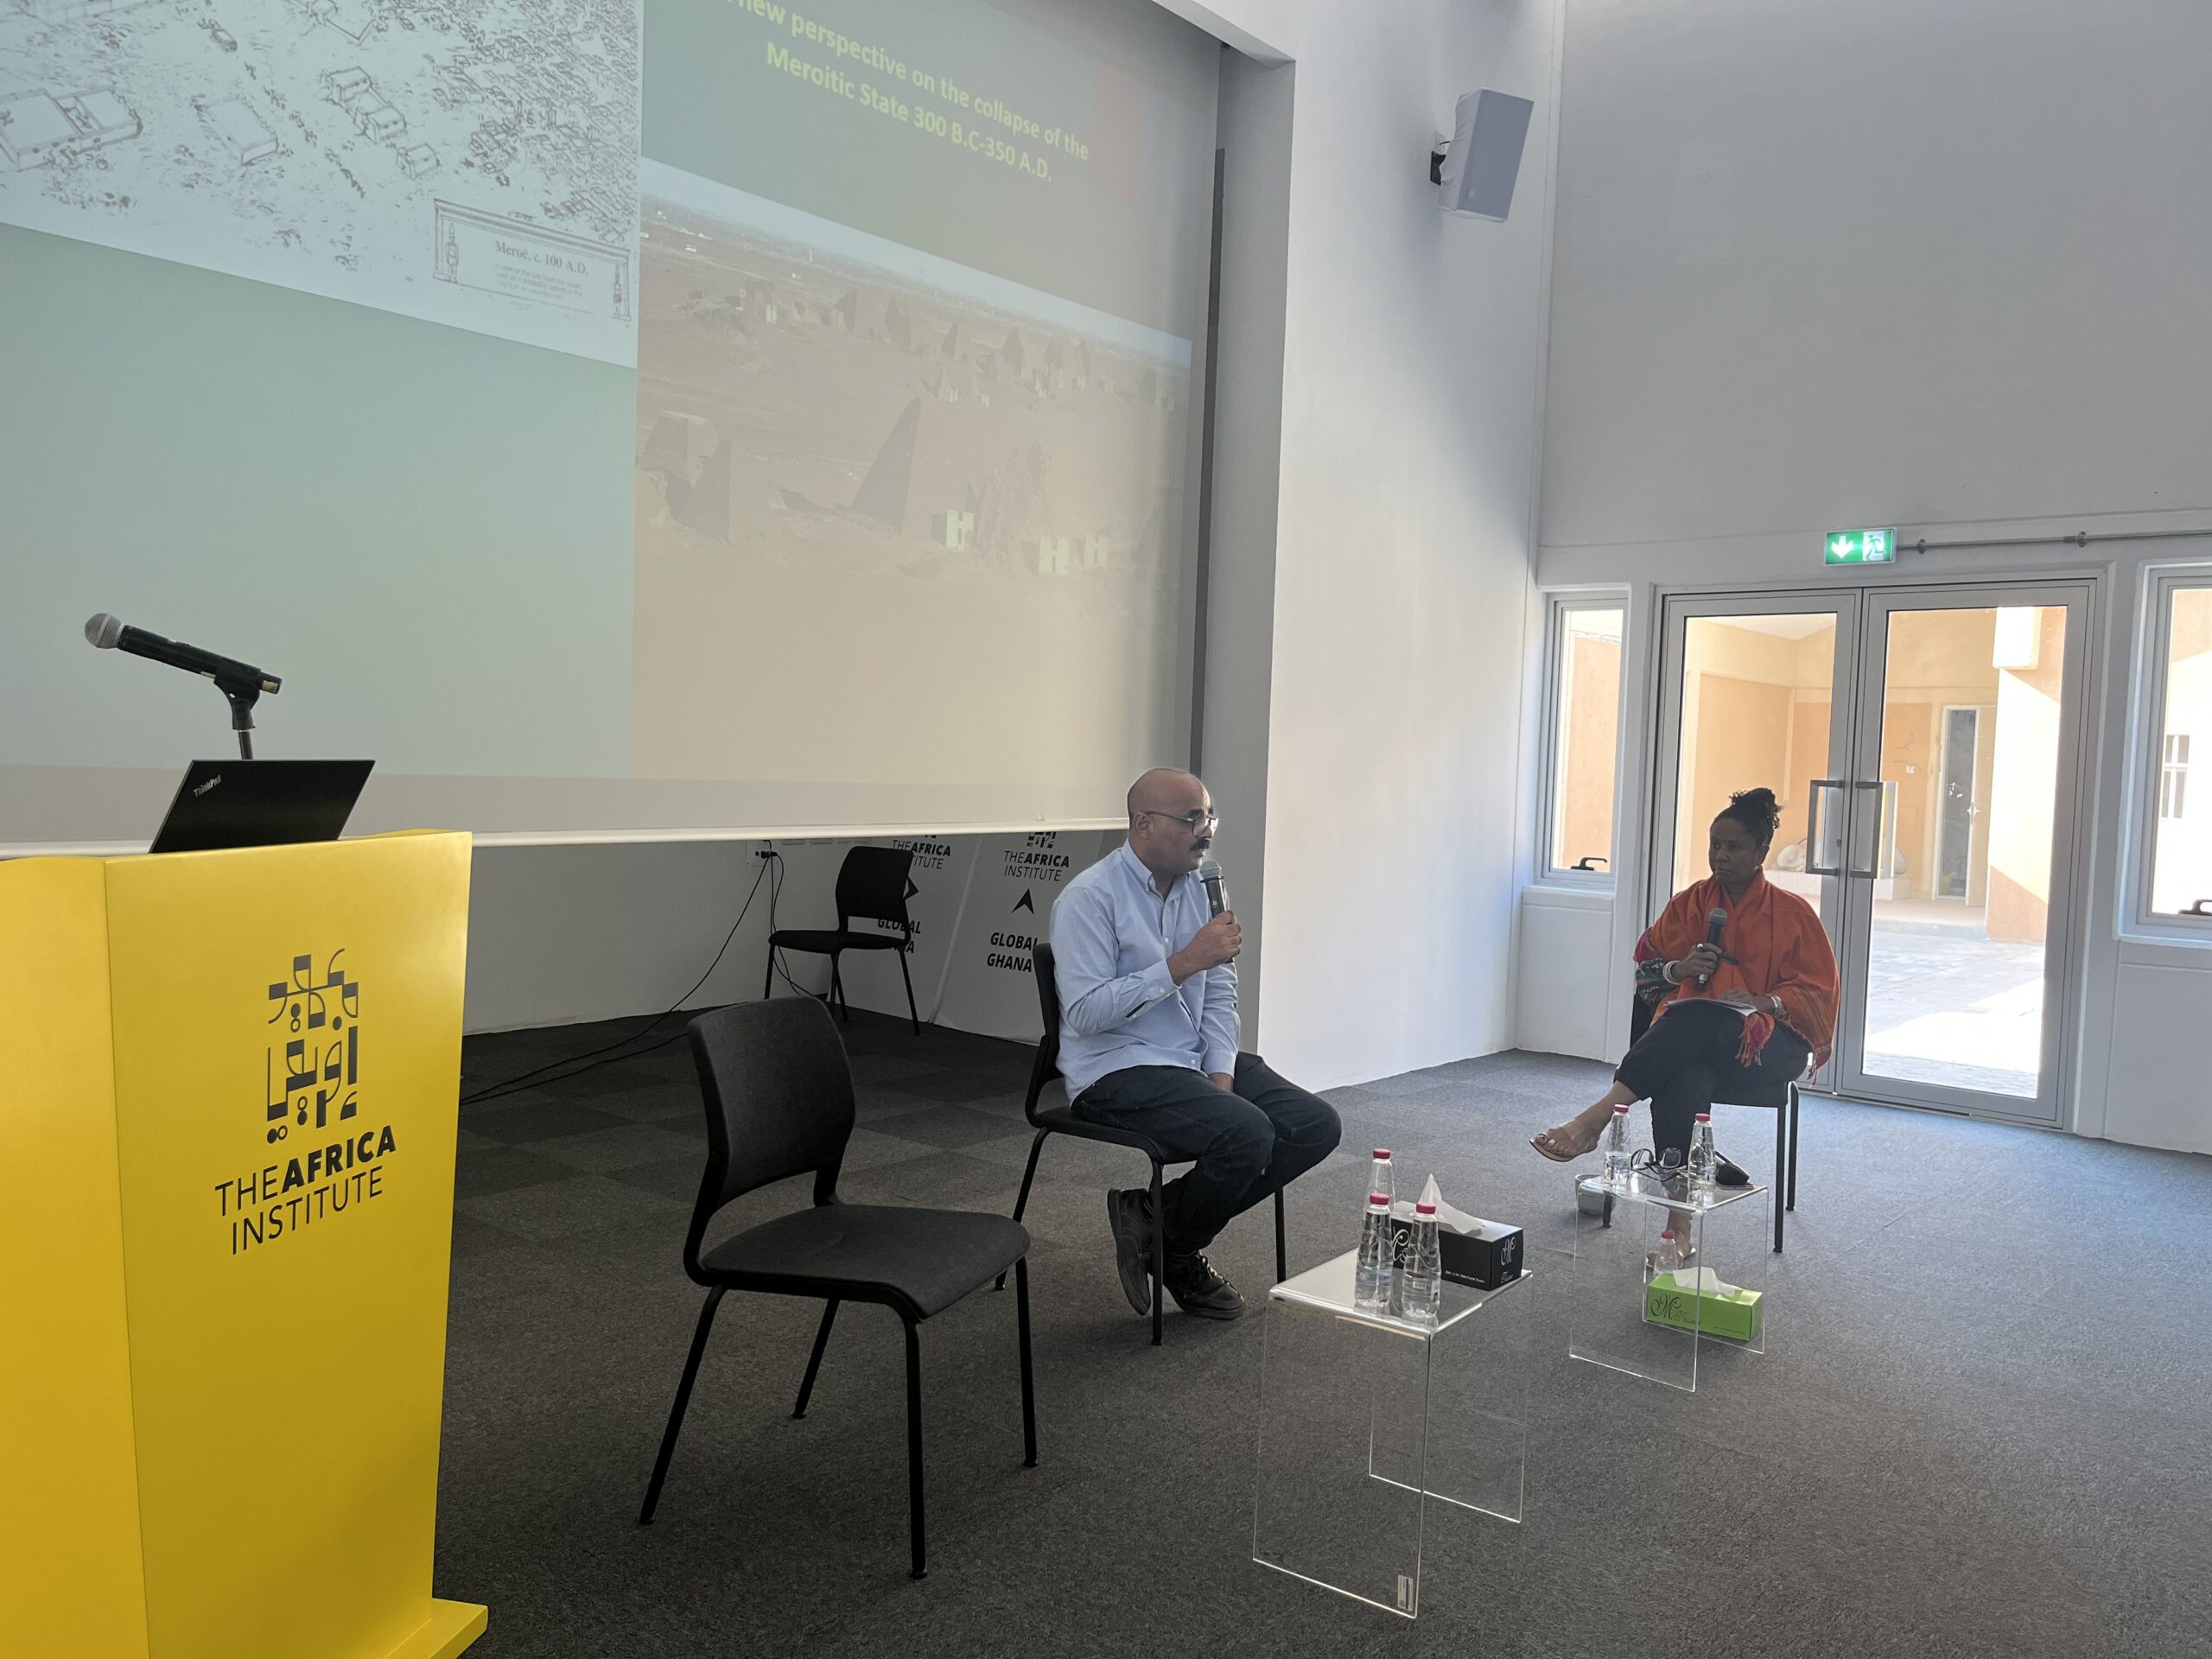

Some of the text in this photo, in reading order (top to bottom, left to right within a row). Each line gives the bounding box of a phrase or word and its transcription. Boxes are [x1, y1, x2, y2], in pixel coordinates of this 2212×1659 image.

[791, 13, 906, 79] perspective
[912, 69, 935, 92] on
[940, 78, 969, 108] the
[974, 98, 1040, 138] collapse
[1044, 128, 1061, 148] of
[1064, 133, 1090, 160] the
[766, 41, 1052, 181] Meroitic State 300 B.C-350 A.D.
[545, 254, 563, 268] 100
[566, 260, 589, 276] A.D.
[194, 773, 222, 798] ThinkPad
[1004, 865, 1062, 881] INSTITUTE
[987, 953, 1032, 972] GHANA
[232, 1166, 383, 1255] INSTITUTE
